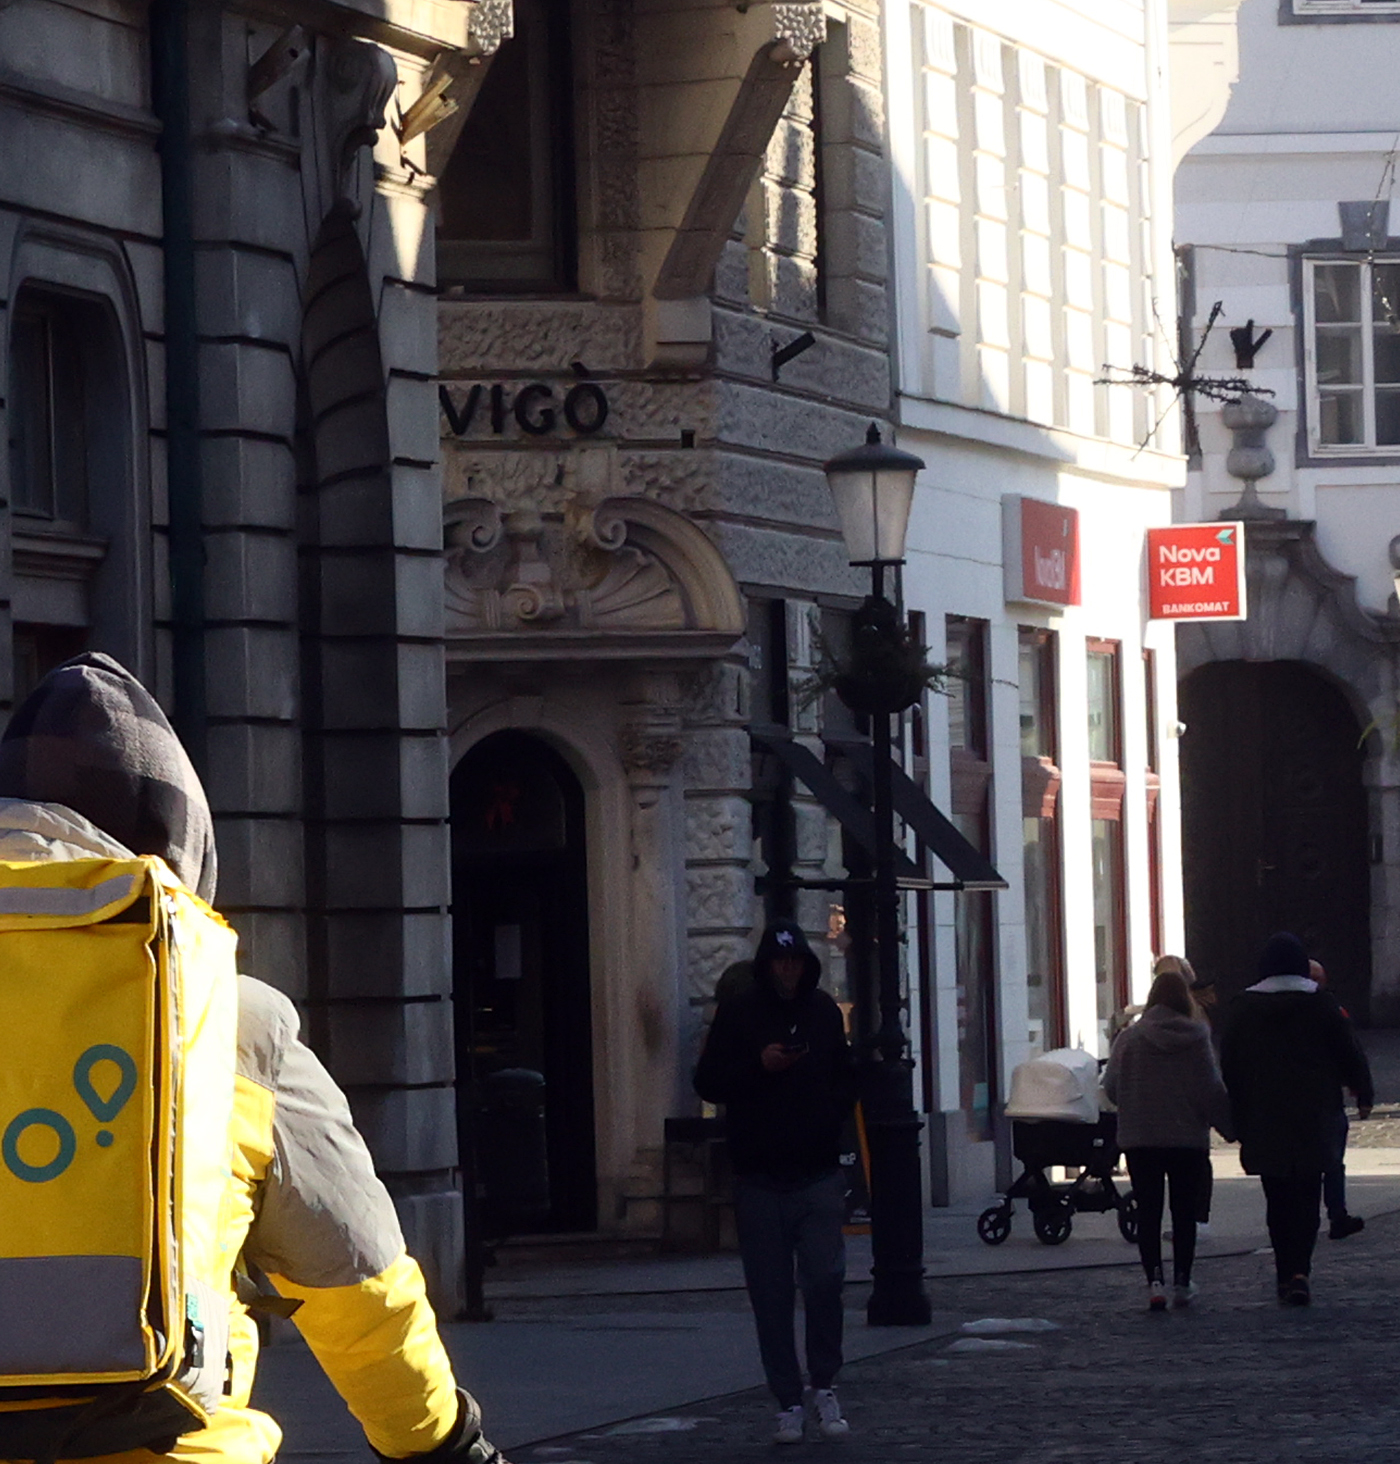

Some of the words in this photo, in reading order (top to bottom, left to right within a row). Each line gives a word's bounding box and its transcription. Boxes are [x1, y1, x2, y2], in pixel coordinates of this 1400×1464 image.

[1159, 545, 1221, 563] Nova
[1160, 566, 1214, 587] KBM
[1162, 601, 1230, 615] BANKOMAT
